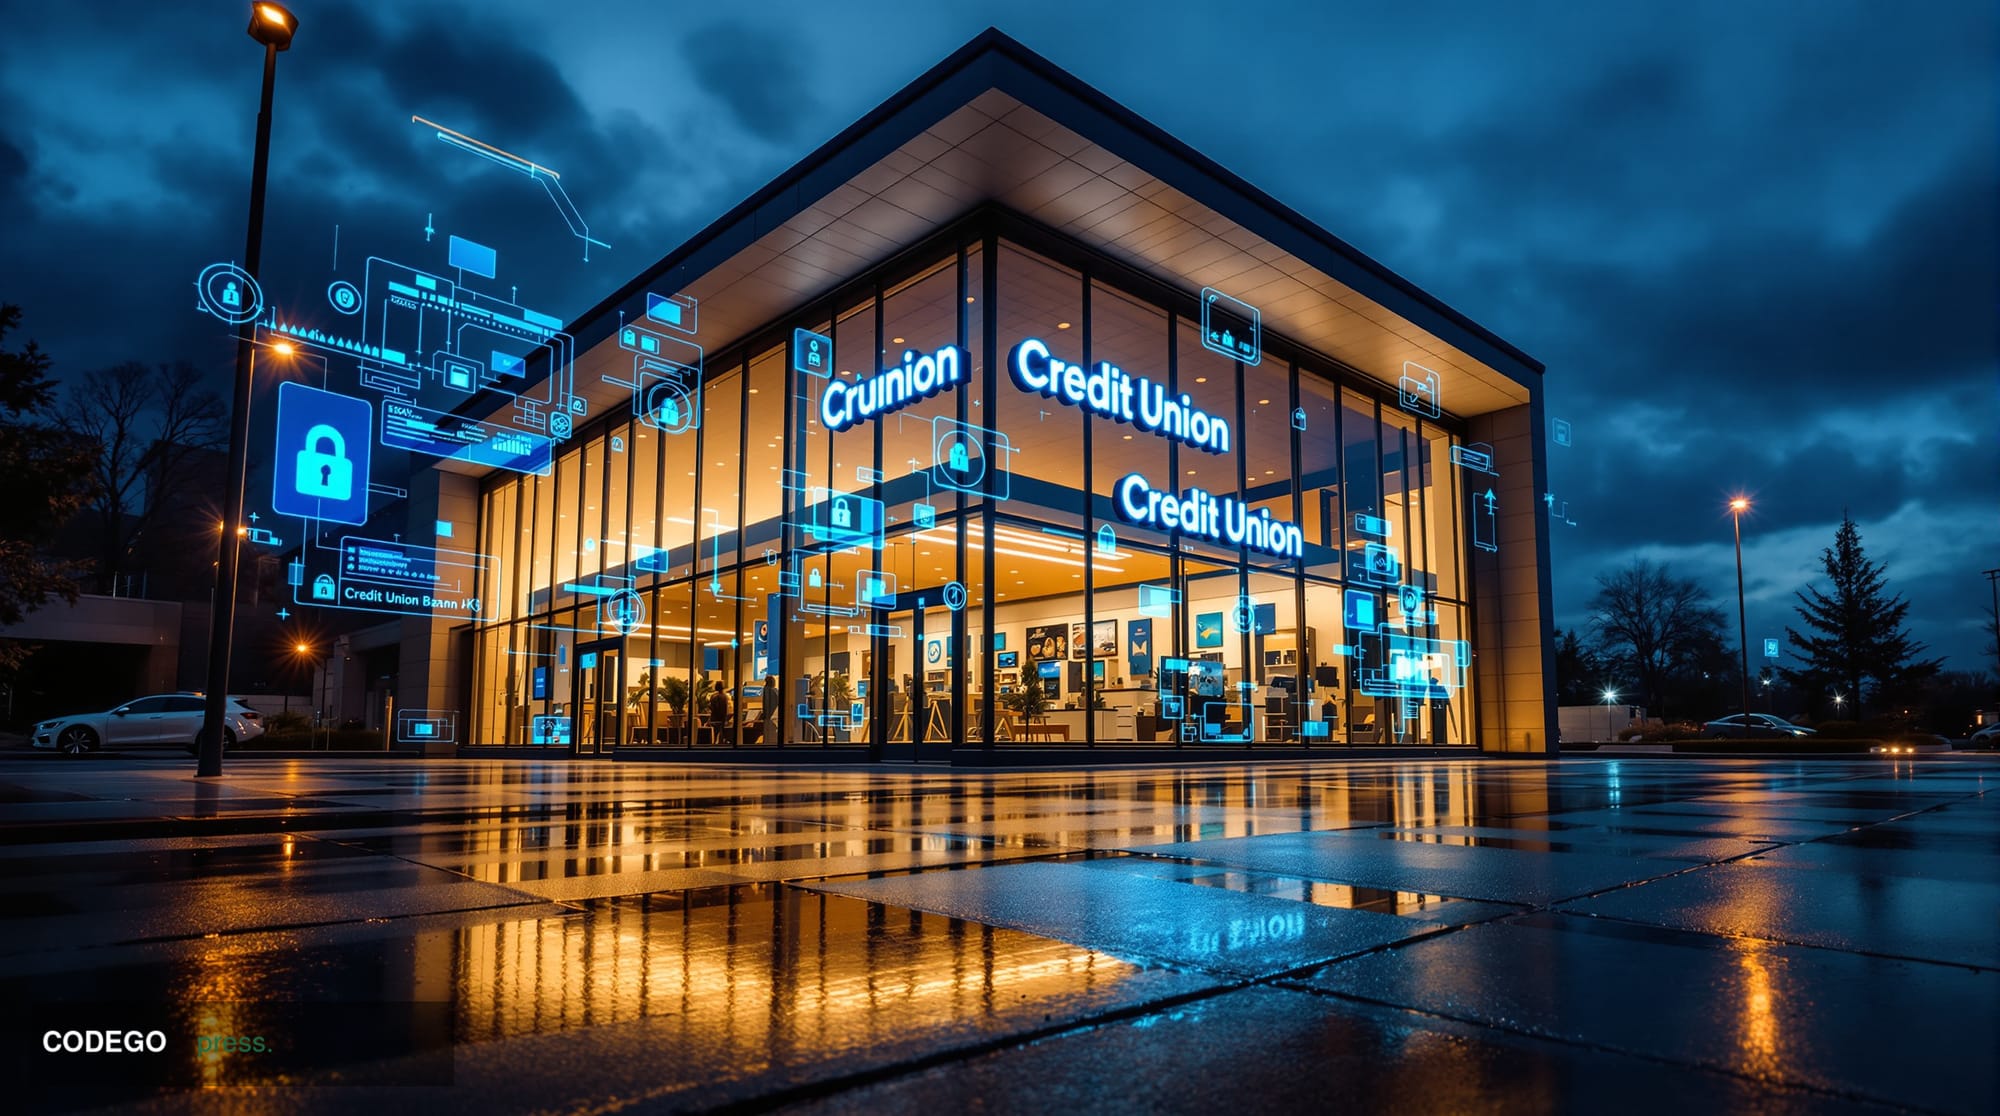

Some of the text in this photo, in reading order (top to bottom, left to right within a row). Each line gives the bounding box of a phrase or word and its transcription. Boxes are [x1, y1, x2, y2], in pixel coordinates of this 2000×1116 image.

[1016, 337, 1231, 453] Credit Union
[1119, 472, 1303, 558] Credit Union
[344, 587, 382, 603] Credit
[386, 592, 419, 606] Union
